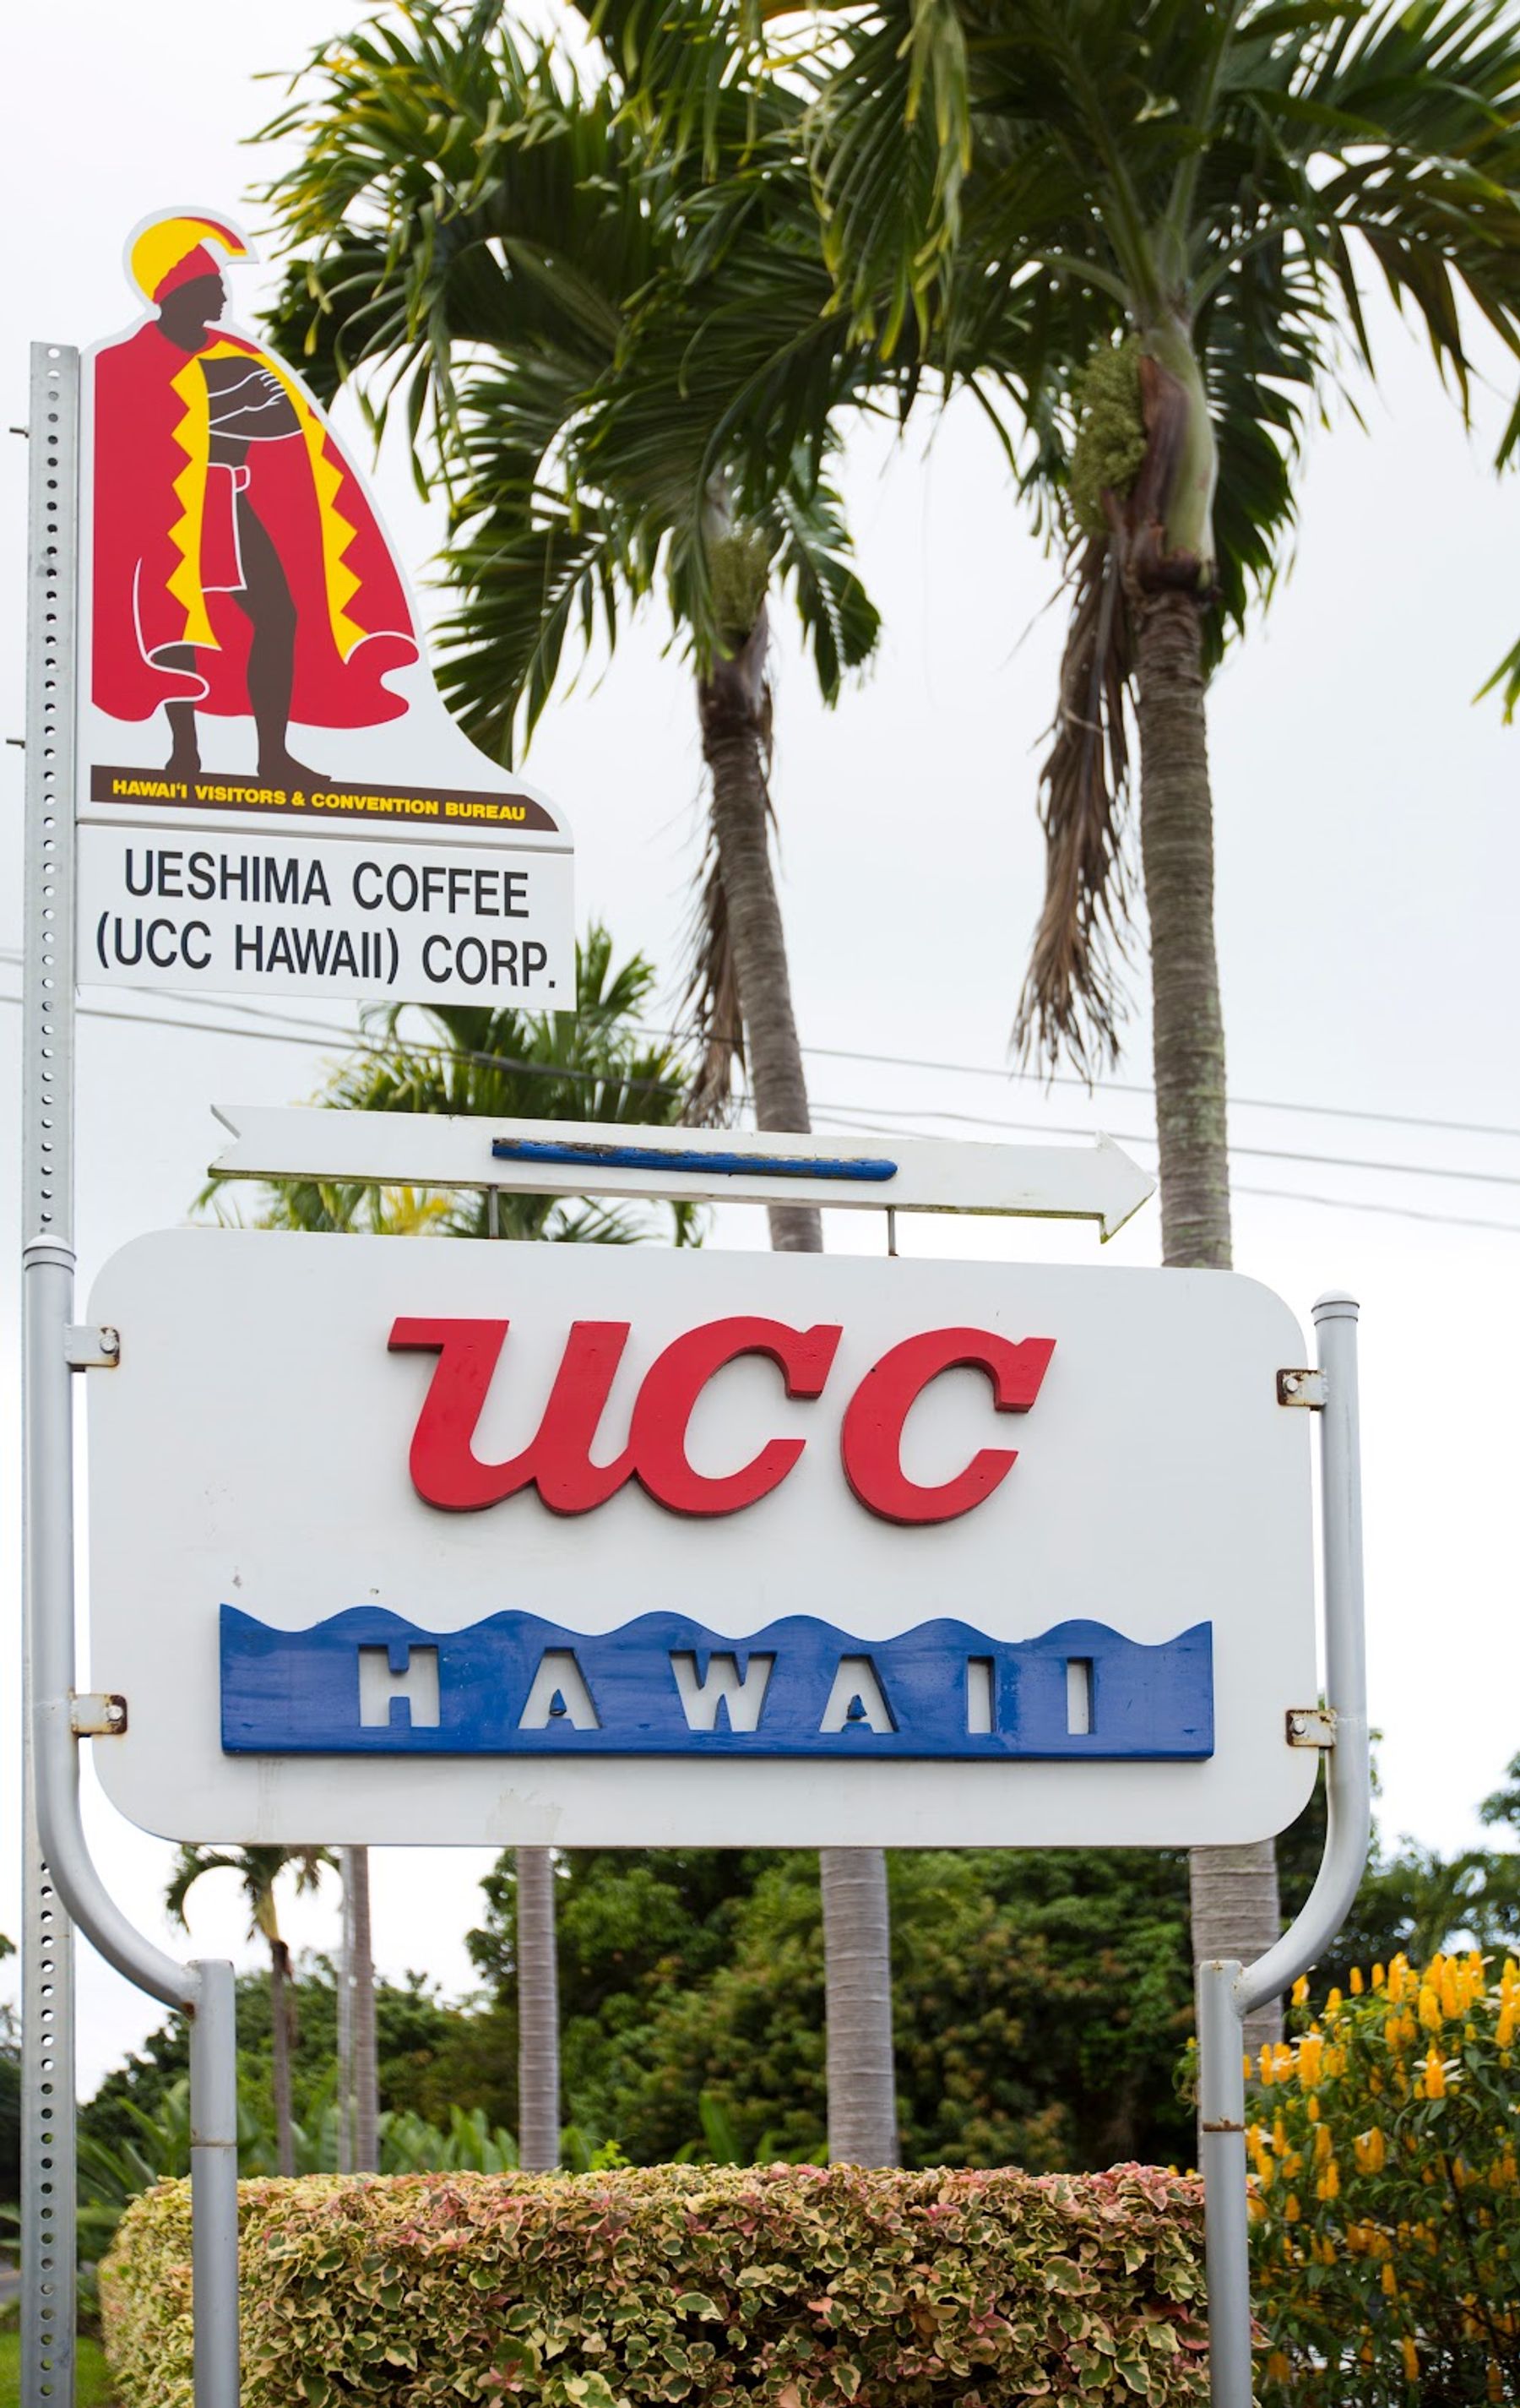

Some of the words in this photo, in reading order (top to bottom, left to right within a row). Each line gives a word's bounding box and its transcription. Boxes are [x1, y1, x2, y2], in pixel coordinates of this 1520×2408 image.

[193, 784, 288, 806] VISITORS
[290, 790, 307, 807] &
[310, 791, 440, 816] CONVENTION
[444, 801, 527, 822] BUREAU
[125, 848, 331, 906] UESHIMA
[352, 862, 529, 918] COFFEE
[96, 910, 212, 970] (UCC
[235, 924, 399, 985] HAWAII)
[422, 934, 556, 989] CORP.
[356, 1644, 1095, 1737] HAWAII
